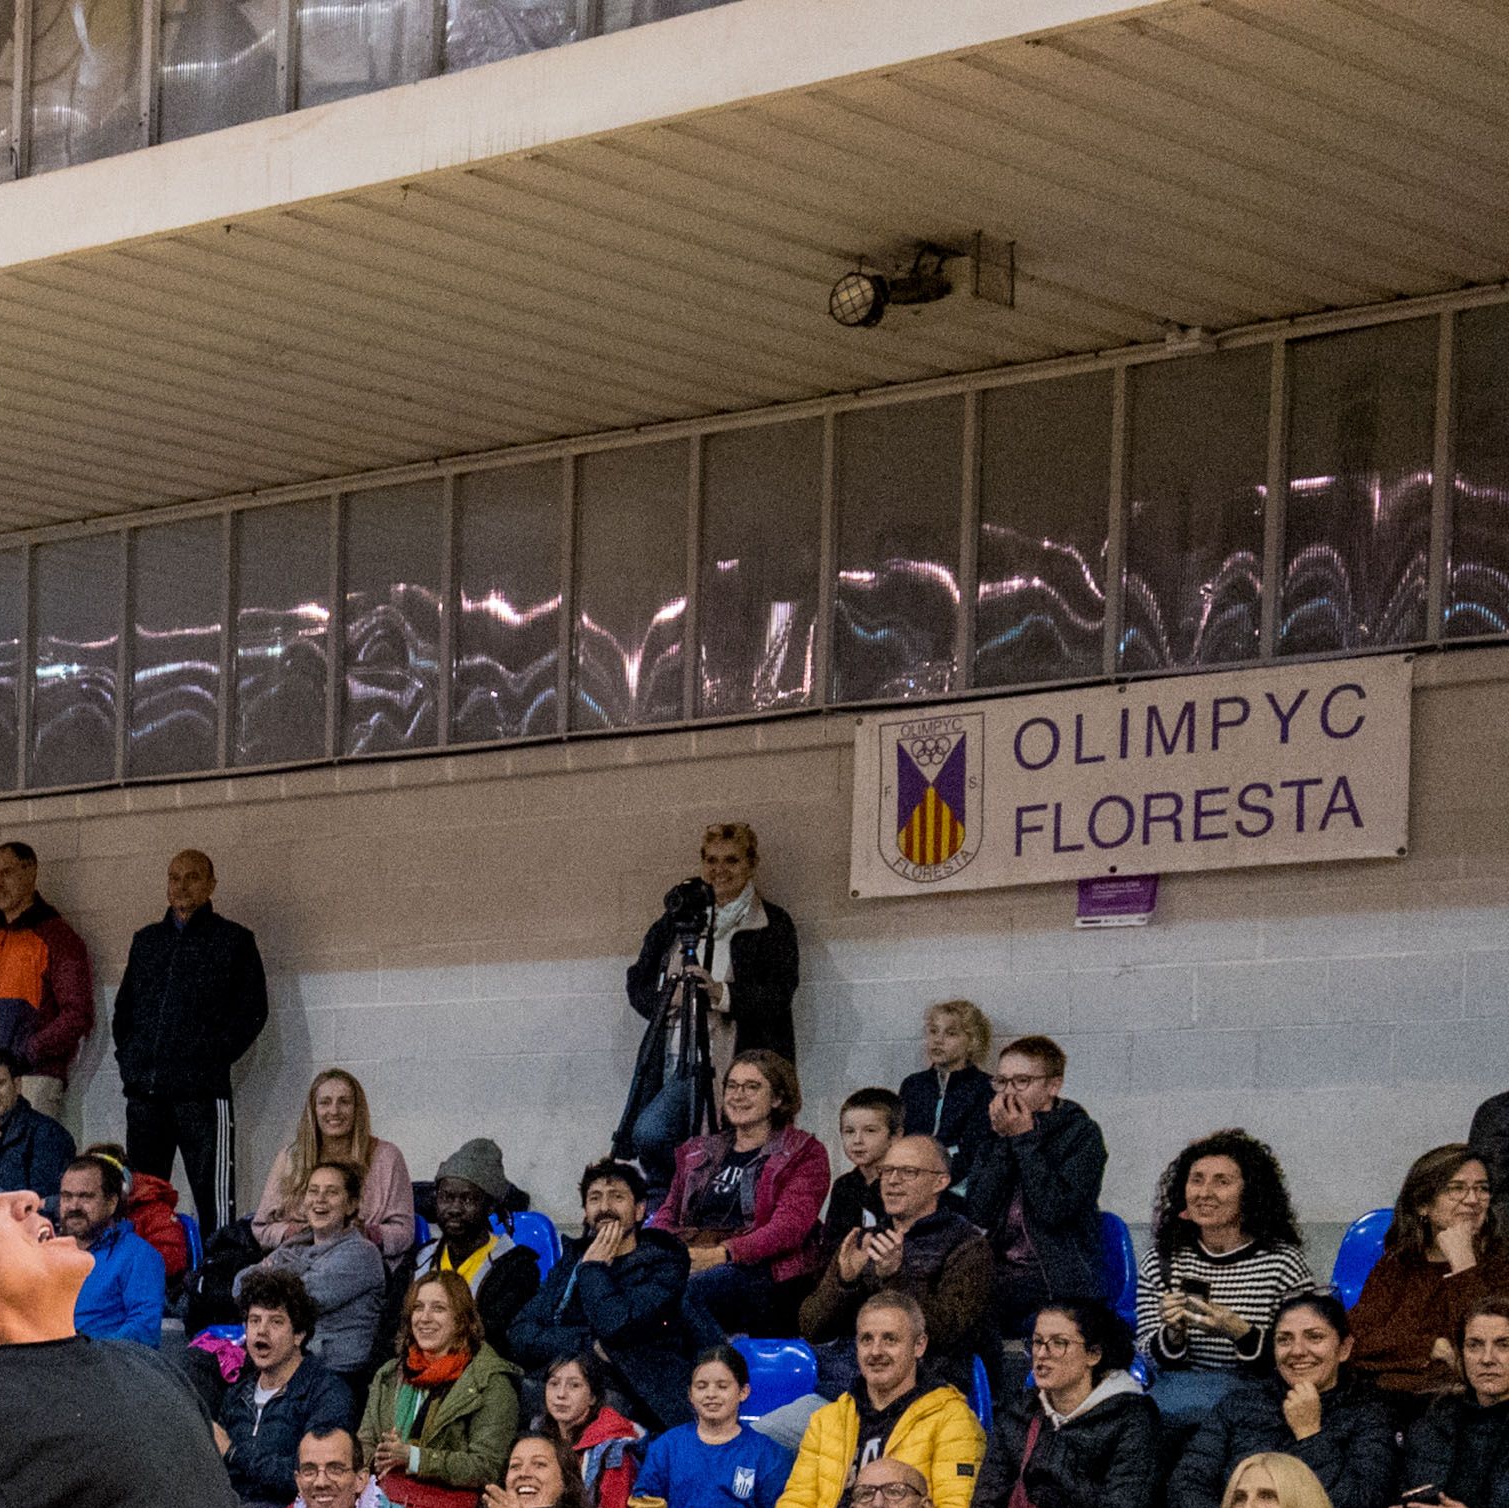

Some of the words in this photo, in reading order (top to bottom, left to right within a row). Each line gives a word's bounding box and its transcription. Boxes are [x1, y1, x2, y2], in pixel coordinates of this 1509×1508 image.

[900, 717, 964, 738] OLIMPYC
[1014, 683, 1366, 771] OLIMPYC
[1014, 776, 1365, 857] FLORESTA
[892, 850, 974, 880] FLORESTA
